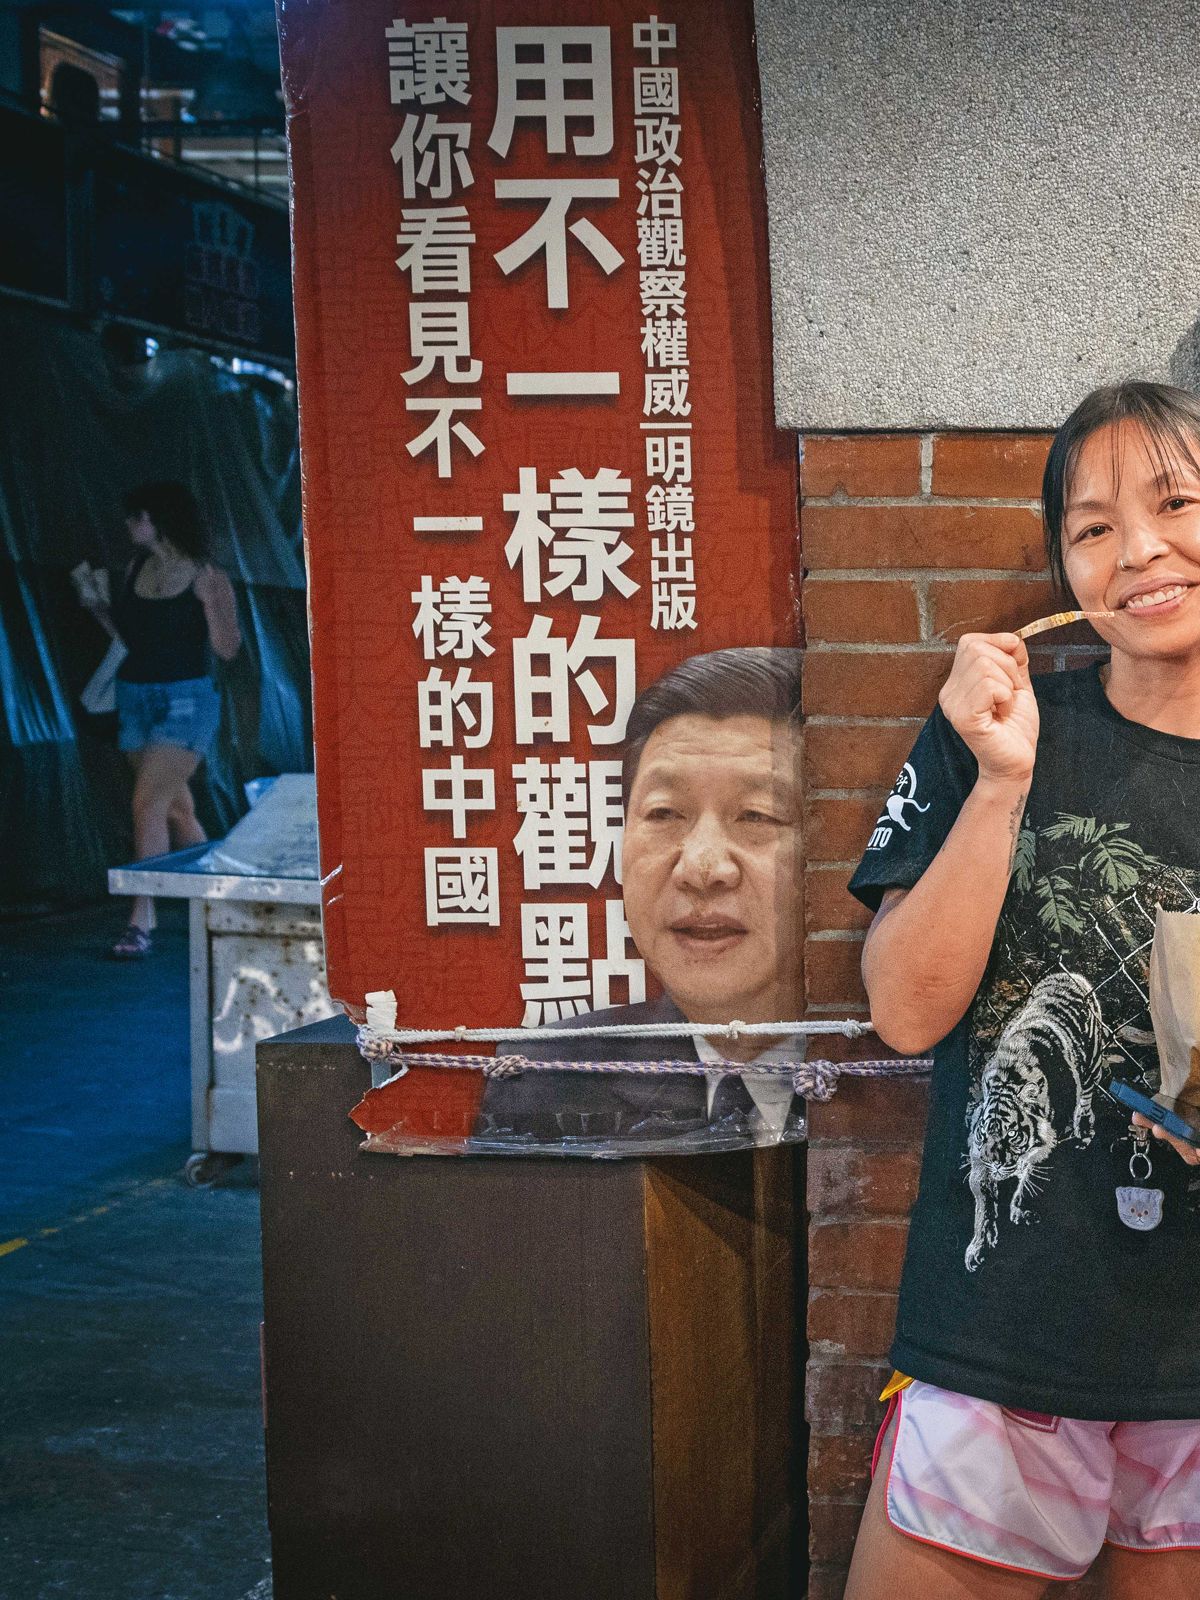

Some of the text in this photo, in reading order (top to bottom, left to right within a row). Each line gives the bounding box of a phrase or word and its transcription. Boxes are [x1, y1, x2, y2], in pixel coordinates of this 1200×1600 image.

[384, 17, 501, 928] 讓你看見不一樣的中國
[487, 25, 647, 1028] 用不一樣的觀點
[644, 435, 698, 631] 明鏡出版
